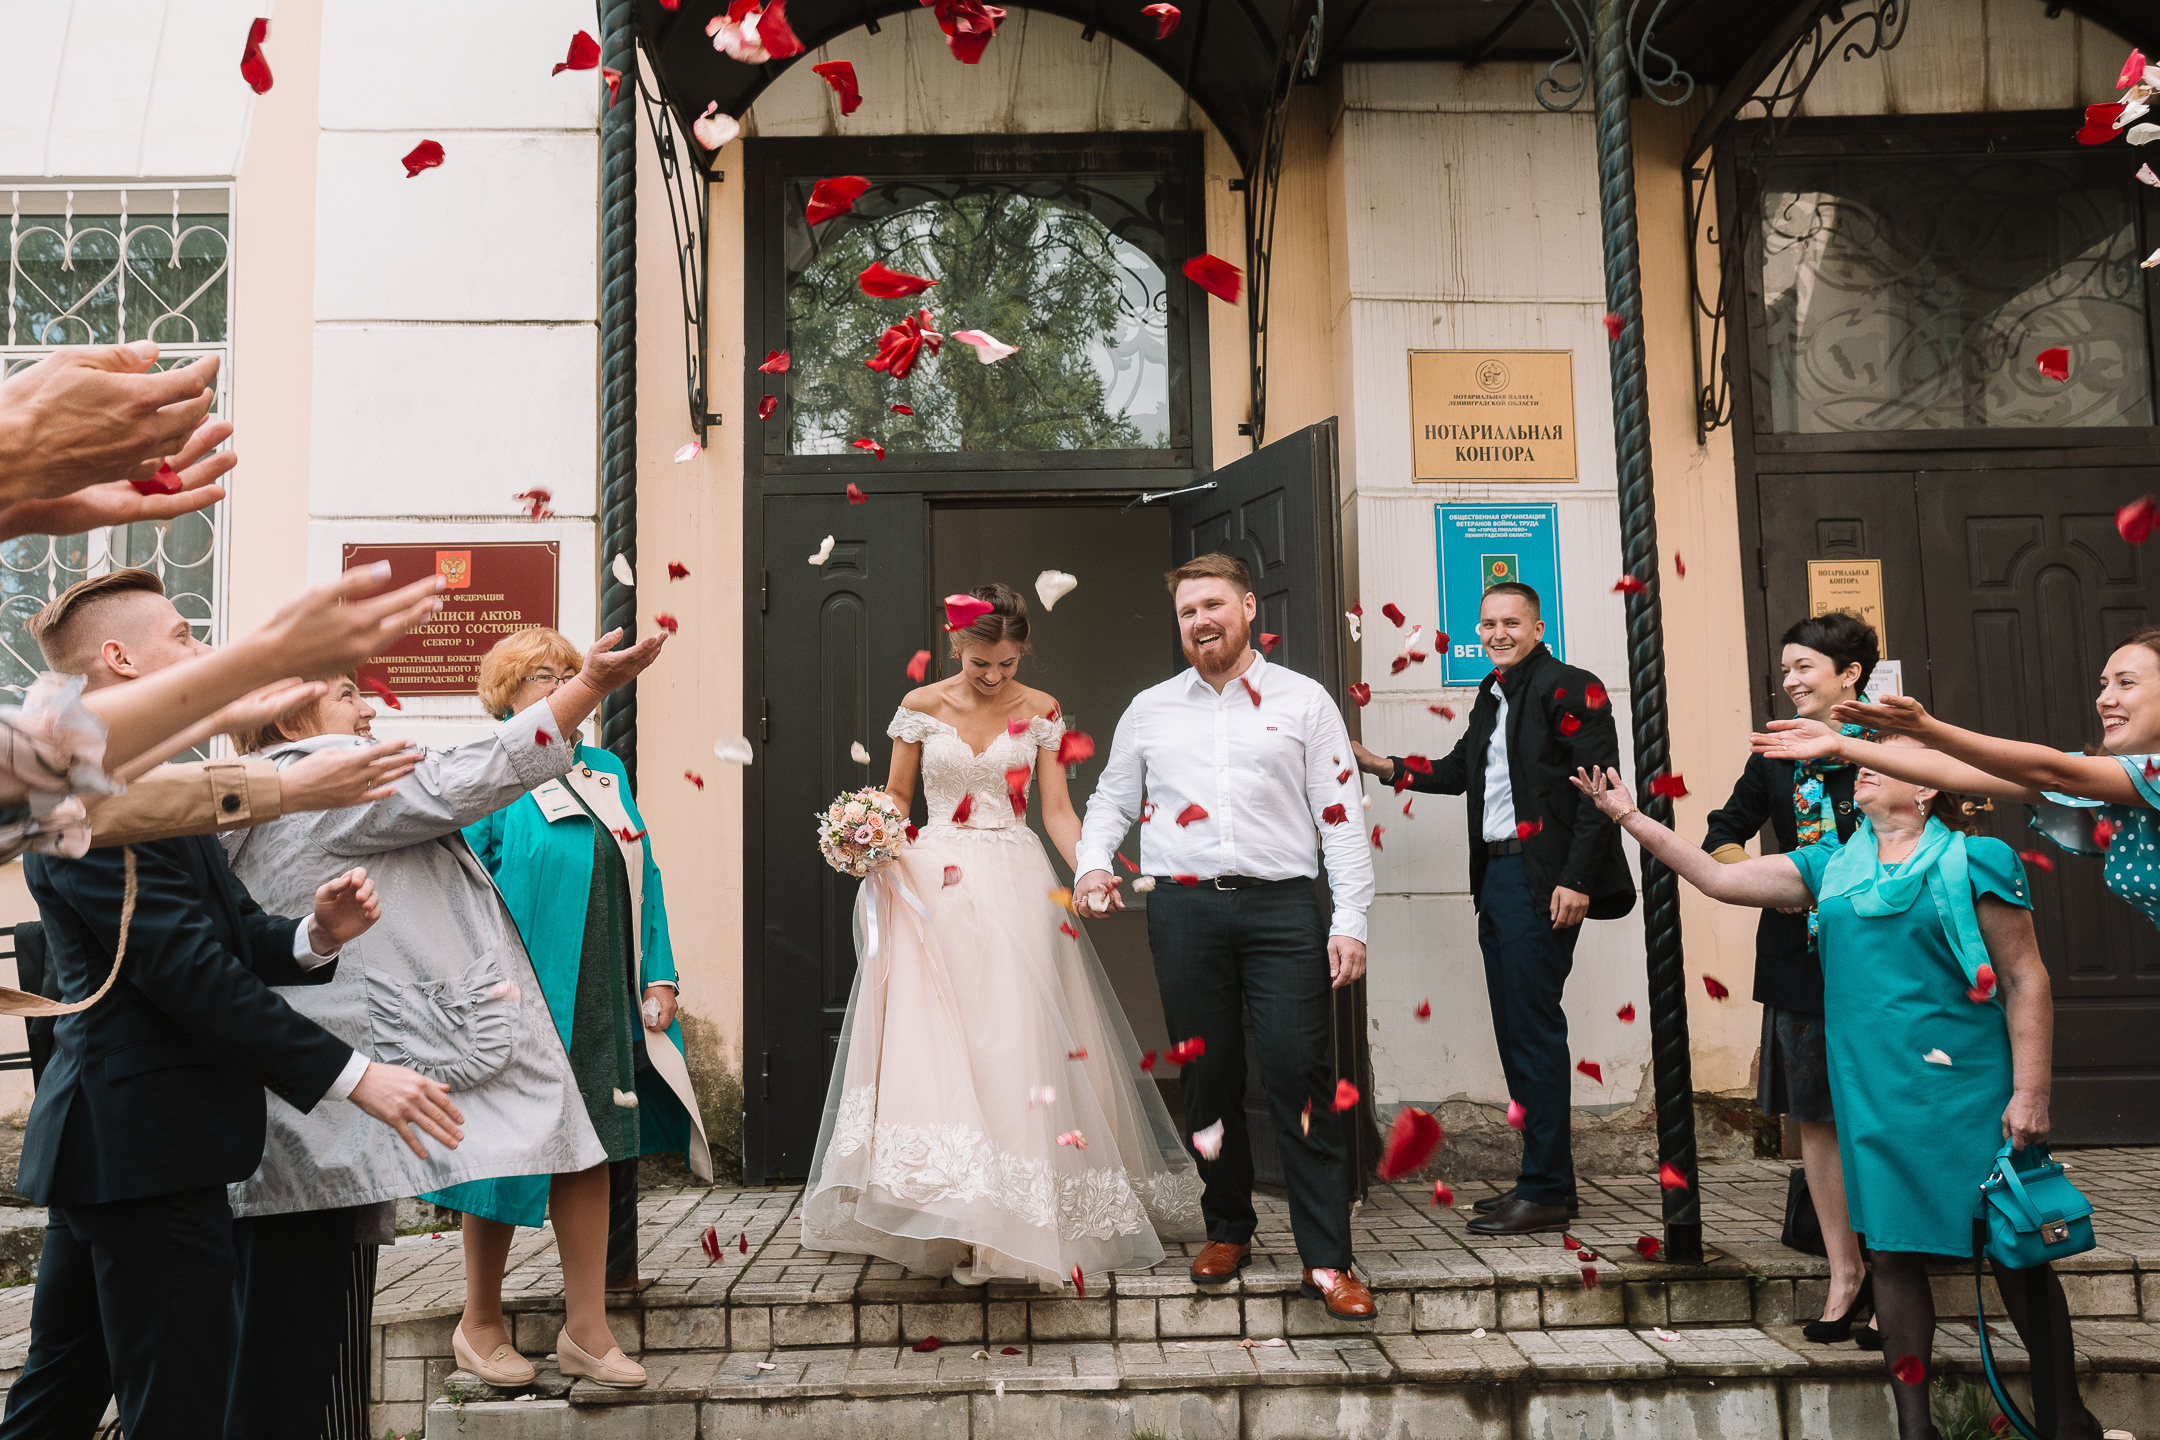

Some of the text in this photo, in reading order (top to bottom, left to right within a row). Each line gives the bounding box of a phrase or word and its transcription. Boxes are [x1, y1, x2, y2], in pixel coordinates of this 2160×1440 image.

[1424, 424, 1563, 440] НОТАРИАЛЬНАЯ
[1455, 446, 1535, 462] КОНТОРА
[453, 594, 504, 602] ФЕДЕРАЦИЯ
[430, 610, 521, 621] АПИСИ АКТОВ
[422, 638, 475, 648] (СЕКТОР 1)
[366, 655, 444, 664] АДМИНИСТРАЦИИ
[387, 665, 472, 673] МУНИЦИПАЛЬНОГО
[389, 674, 465, 684] ЛЕНИНГРАДСКОЙ
